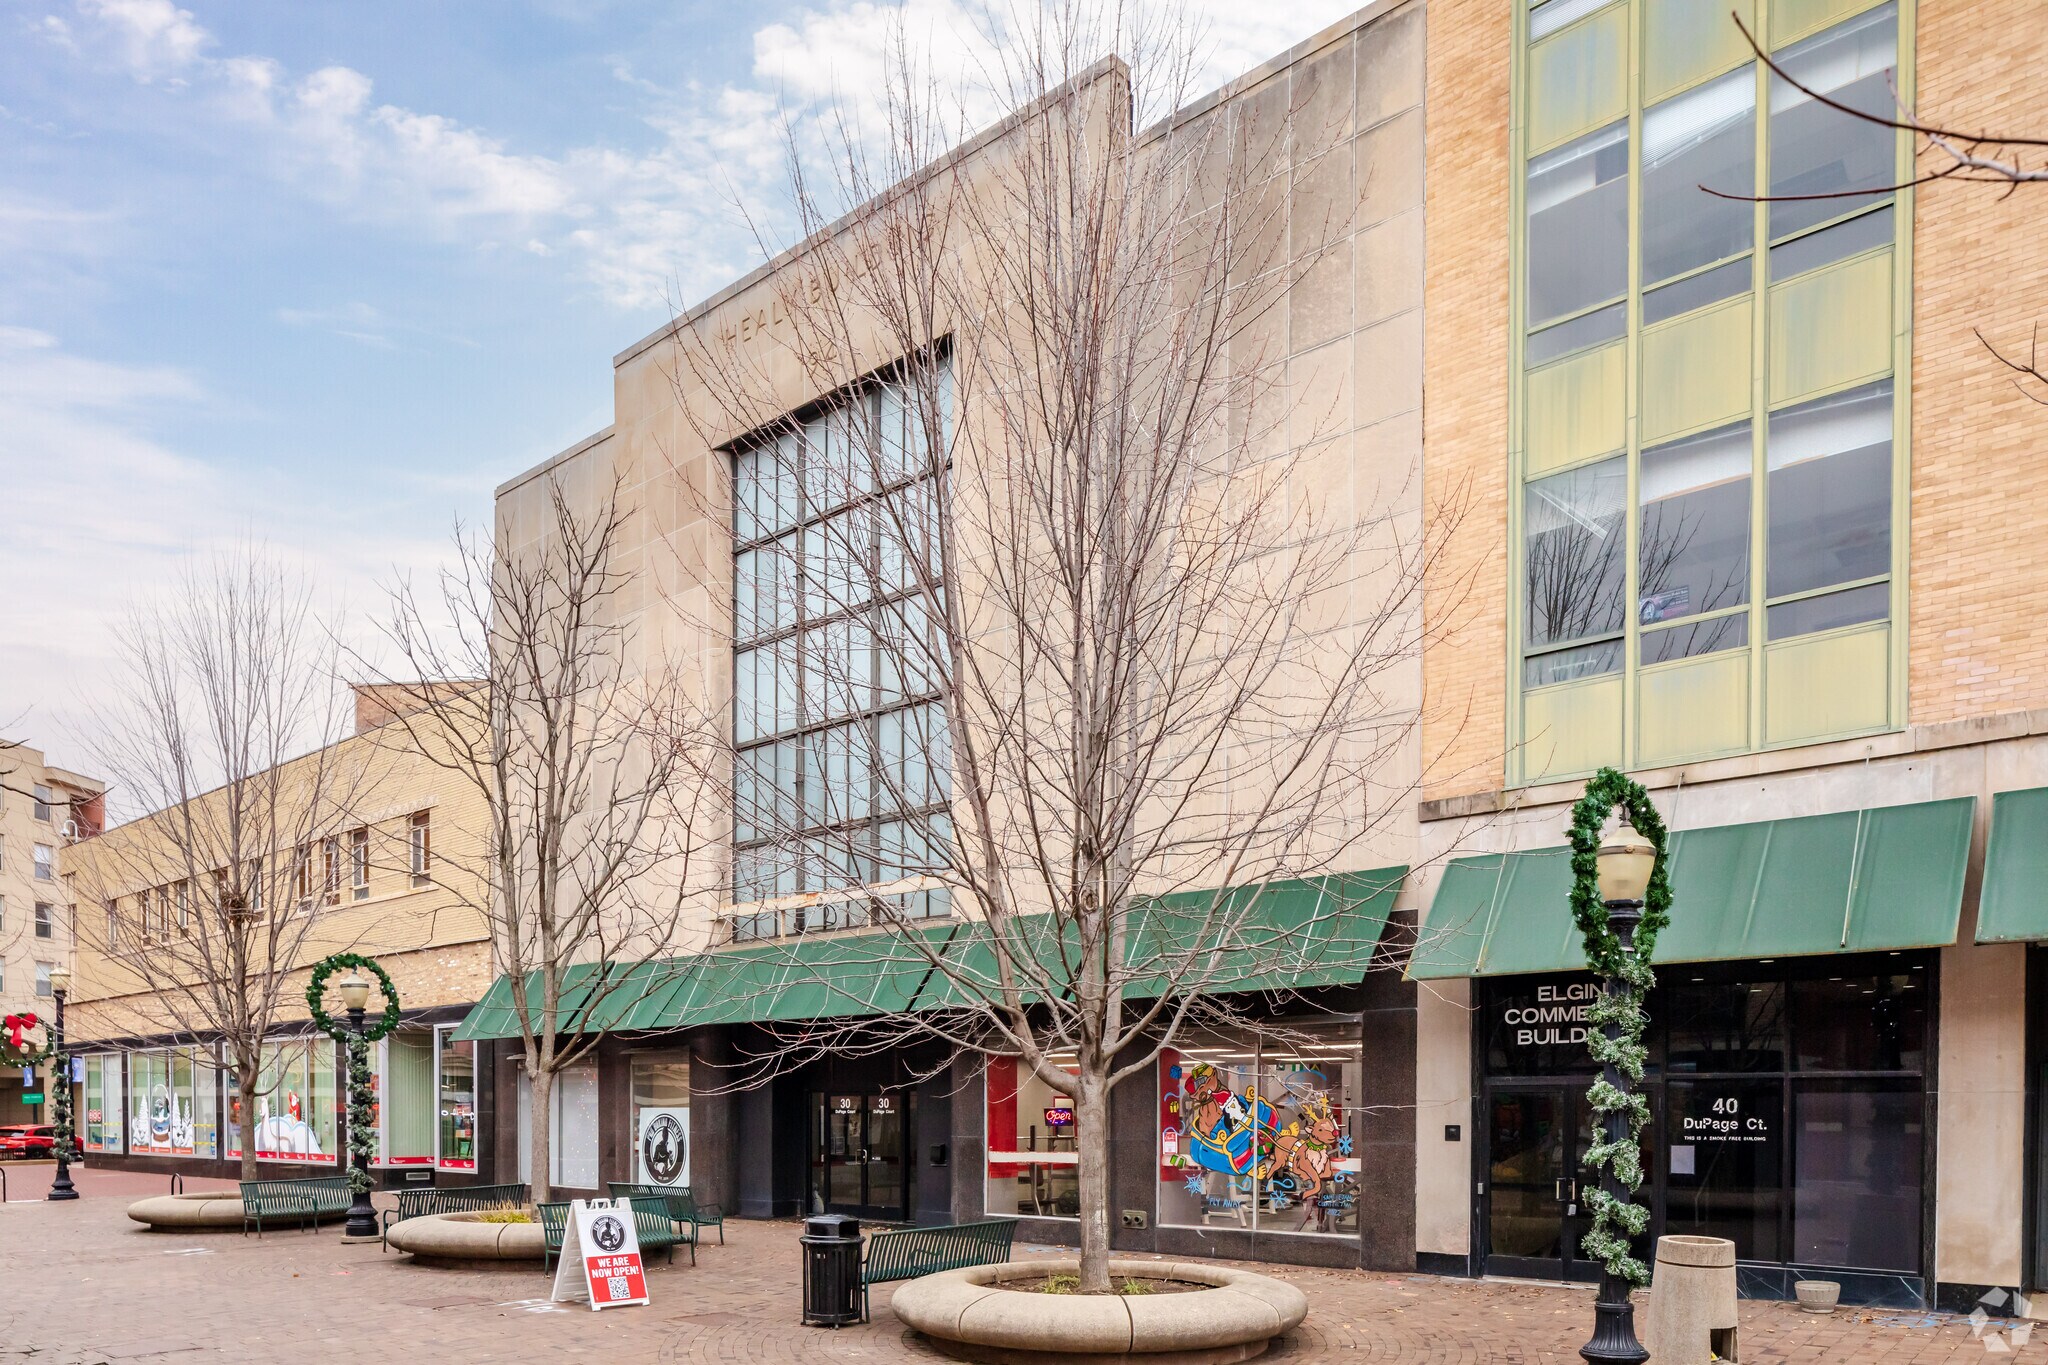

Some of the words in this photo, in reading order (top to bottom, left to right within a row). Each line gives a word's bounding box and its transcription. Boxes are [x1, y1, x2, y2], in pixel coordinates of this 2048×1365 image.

[1537, 982, 1607, 1002] ELGIN
[1504, 1005, 1592, 1025] COMME
[1517, 1027, 1594, 1045] BUILD
[840, 1098, 851, 1109] 30
[878, 1098, 890, 1109] 30
[1712, 1098, 1738, 1114] 40
[1046, 1110, 1071, 1124] Open
[1683, 1117, 1739, 1132] DuPage
[1746, 1118, 1767, 1130] Ct.
[1208, 1197, 1221, 1207] FLY
[1222, 1198, 1241, 1209] AWAY
[597, 1257, 612, 1268] WE
[612, 1256, 629, 1267] ARE
[591, 1267, 612, 1279] NOW
[613, 1265, 639, 1277] OPEN!
